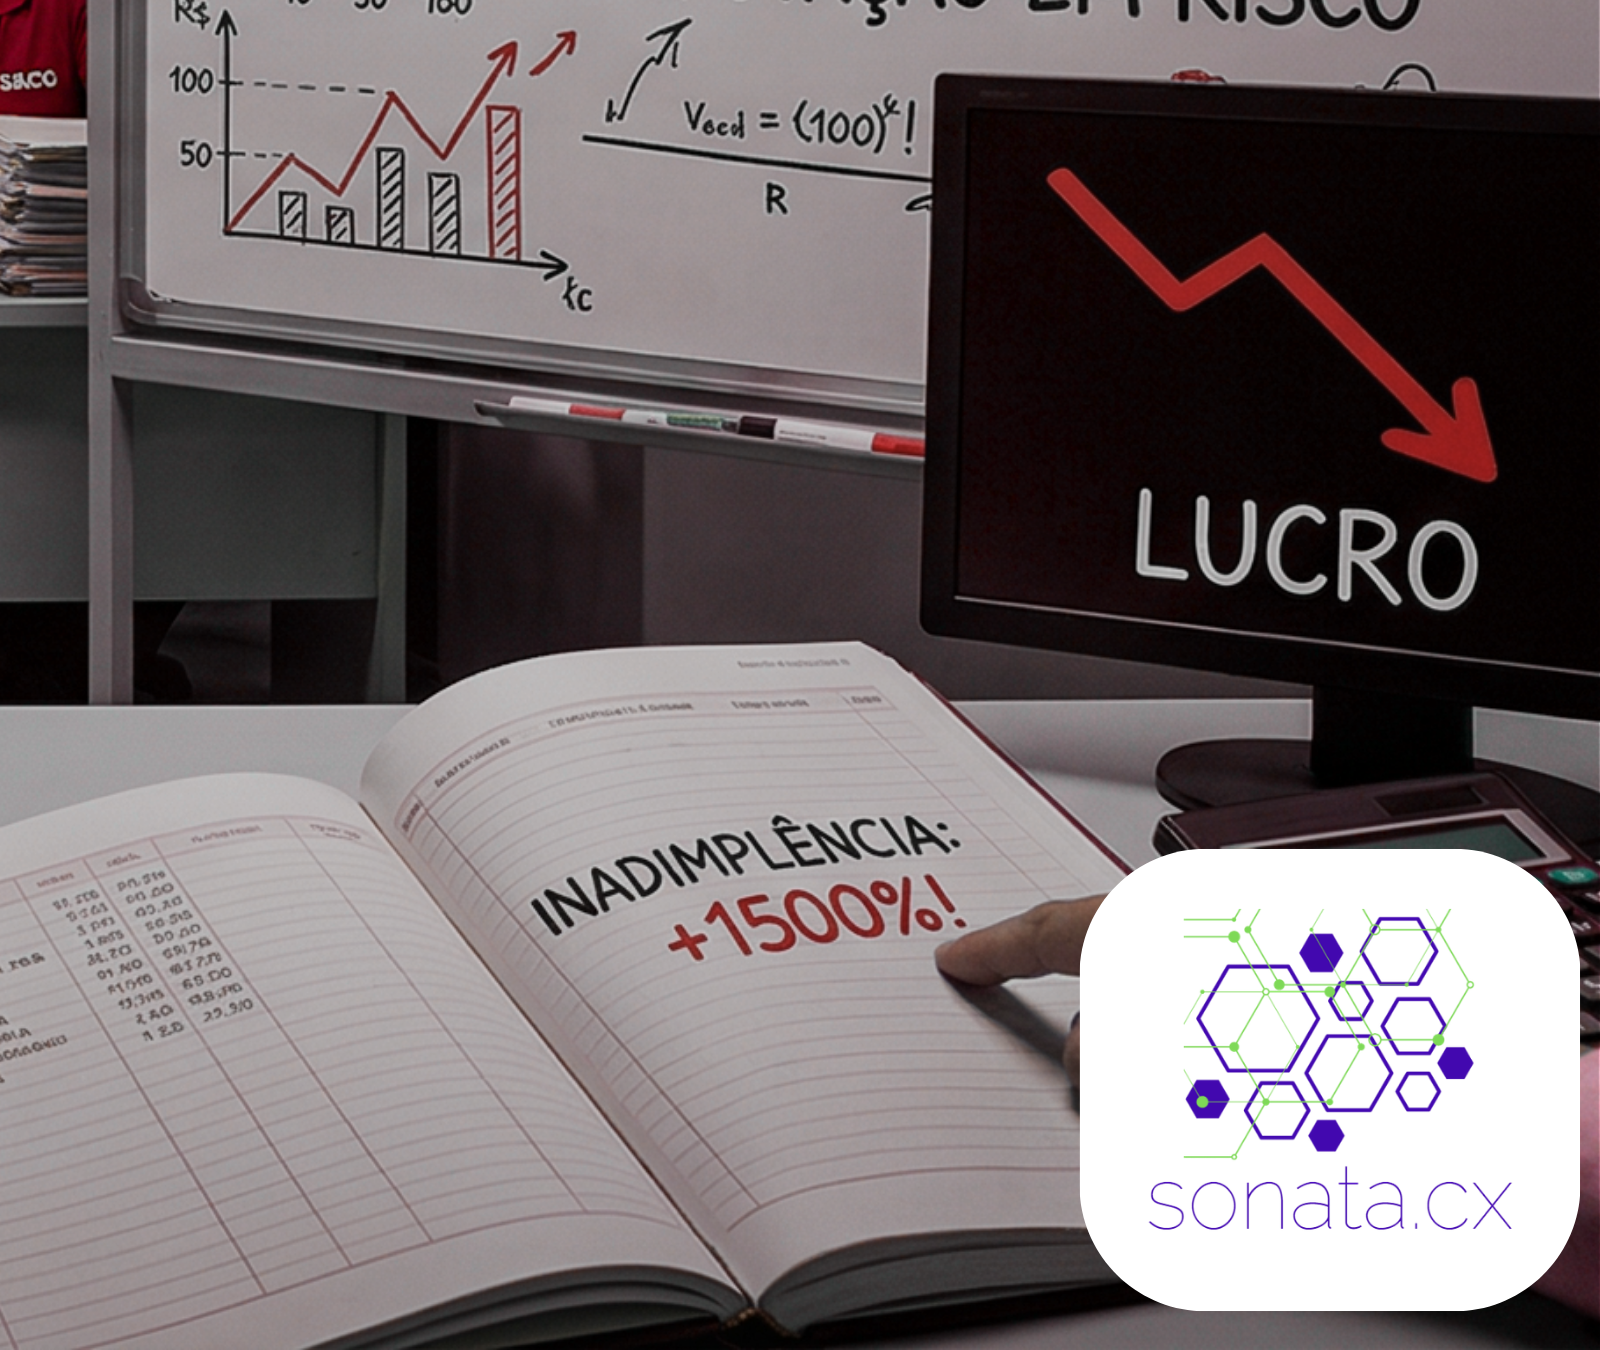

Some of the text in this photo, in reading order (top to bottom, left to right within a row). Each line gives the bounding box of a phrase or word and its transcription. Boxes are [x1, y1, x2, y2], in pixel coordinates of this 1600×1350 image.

[167, 65, 215, 96] 100
[180, 140, 213, 168] 50
[1135, 487, 1479, 612] LUCRO
[530, 813, 962, 937] INADIMPLÊNCIA:
[667, 873, 968, 962] +1500%!
